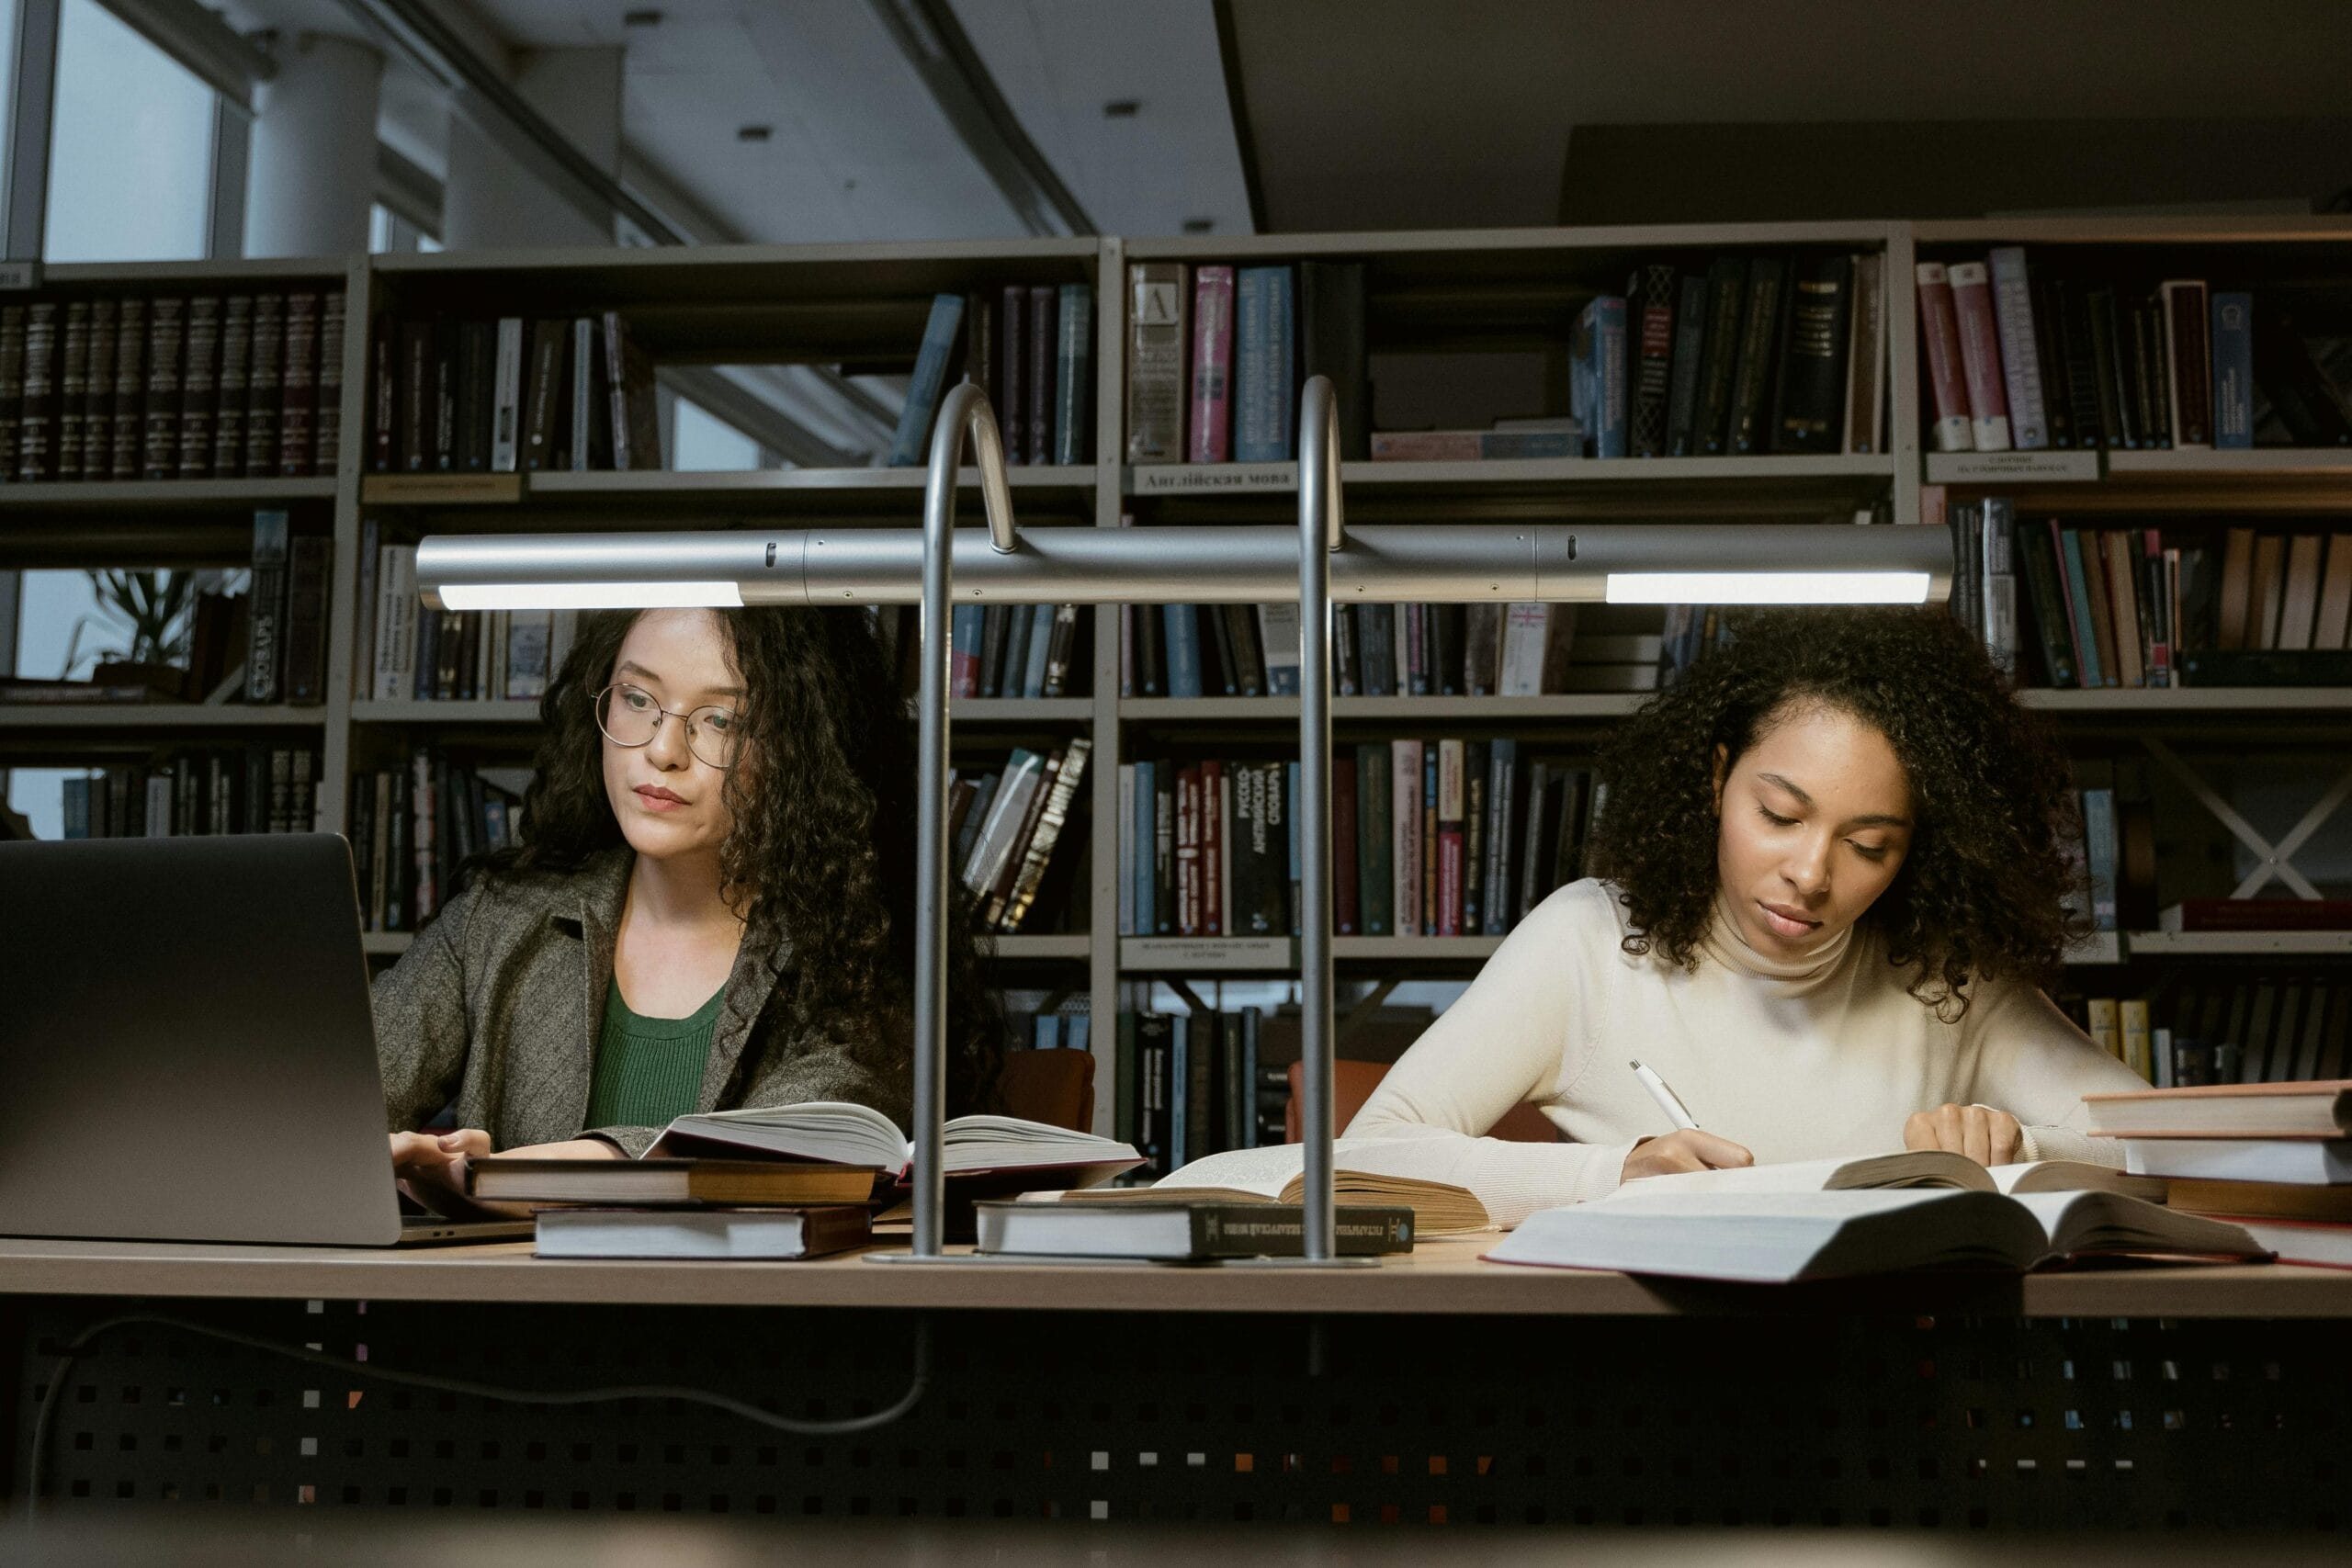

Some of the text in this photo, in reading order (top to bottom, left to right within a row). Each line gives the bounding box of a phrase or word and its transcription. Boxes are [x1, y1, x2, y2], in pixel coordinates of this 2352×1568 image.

[1248, 473, 1291, 485] мова
[1237, 767, 1250, 818] РУССКО-
[1251, 770, 1266, 855] АНГЛИЙСКИЙ
[1267, 770, 1282, 825] СЛОВАРЬ
